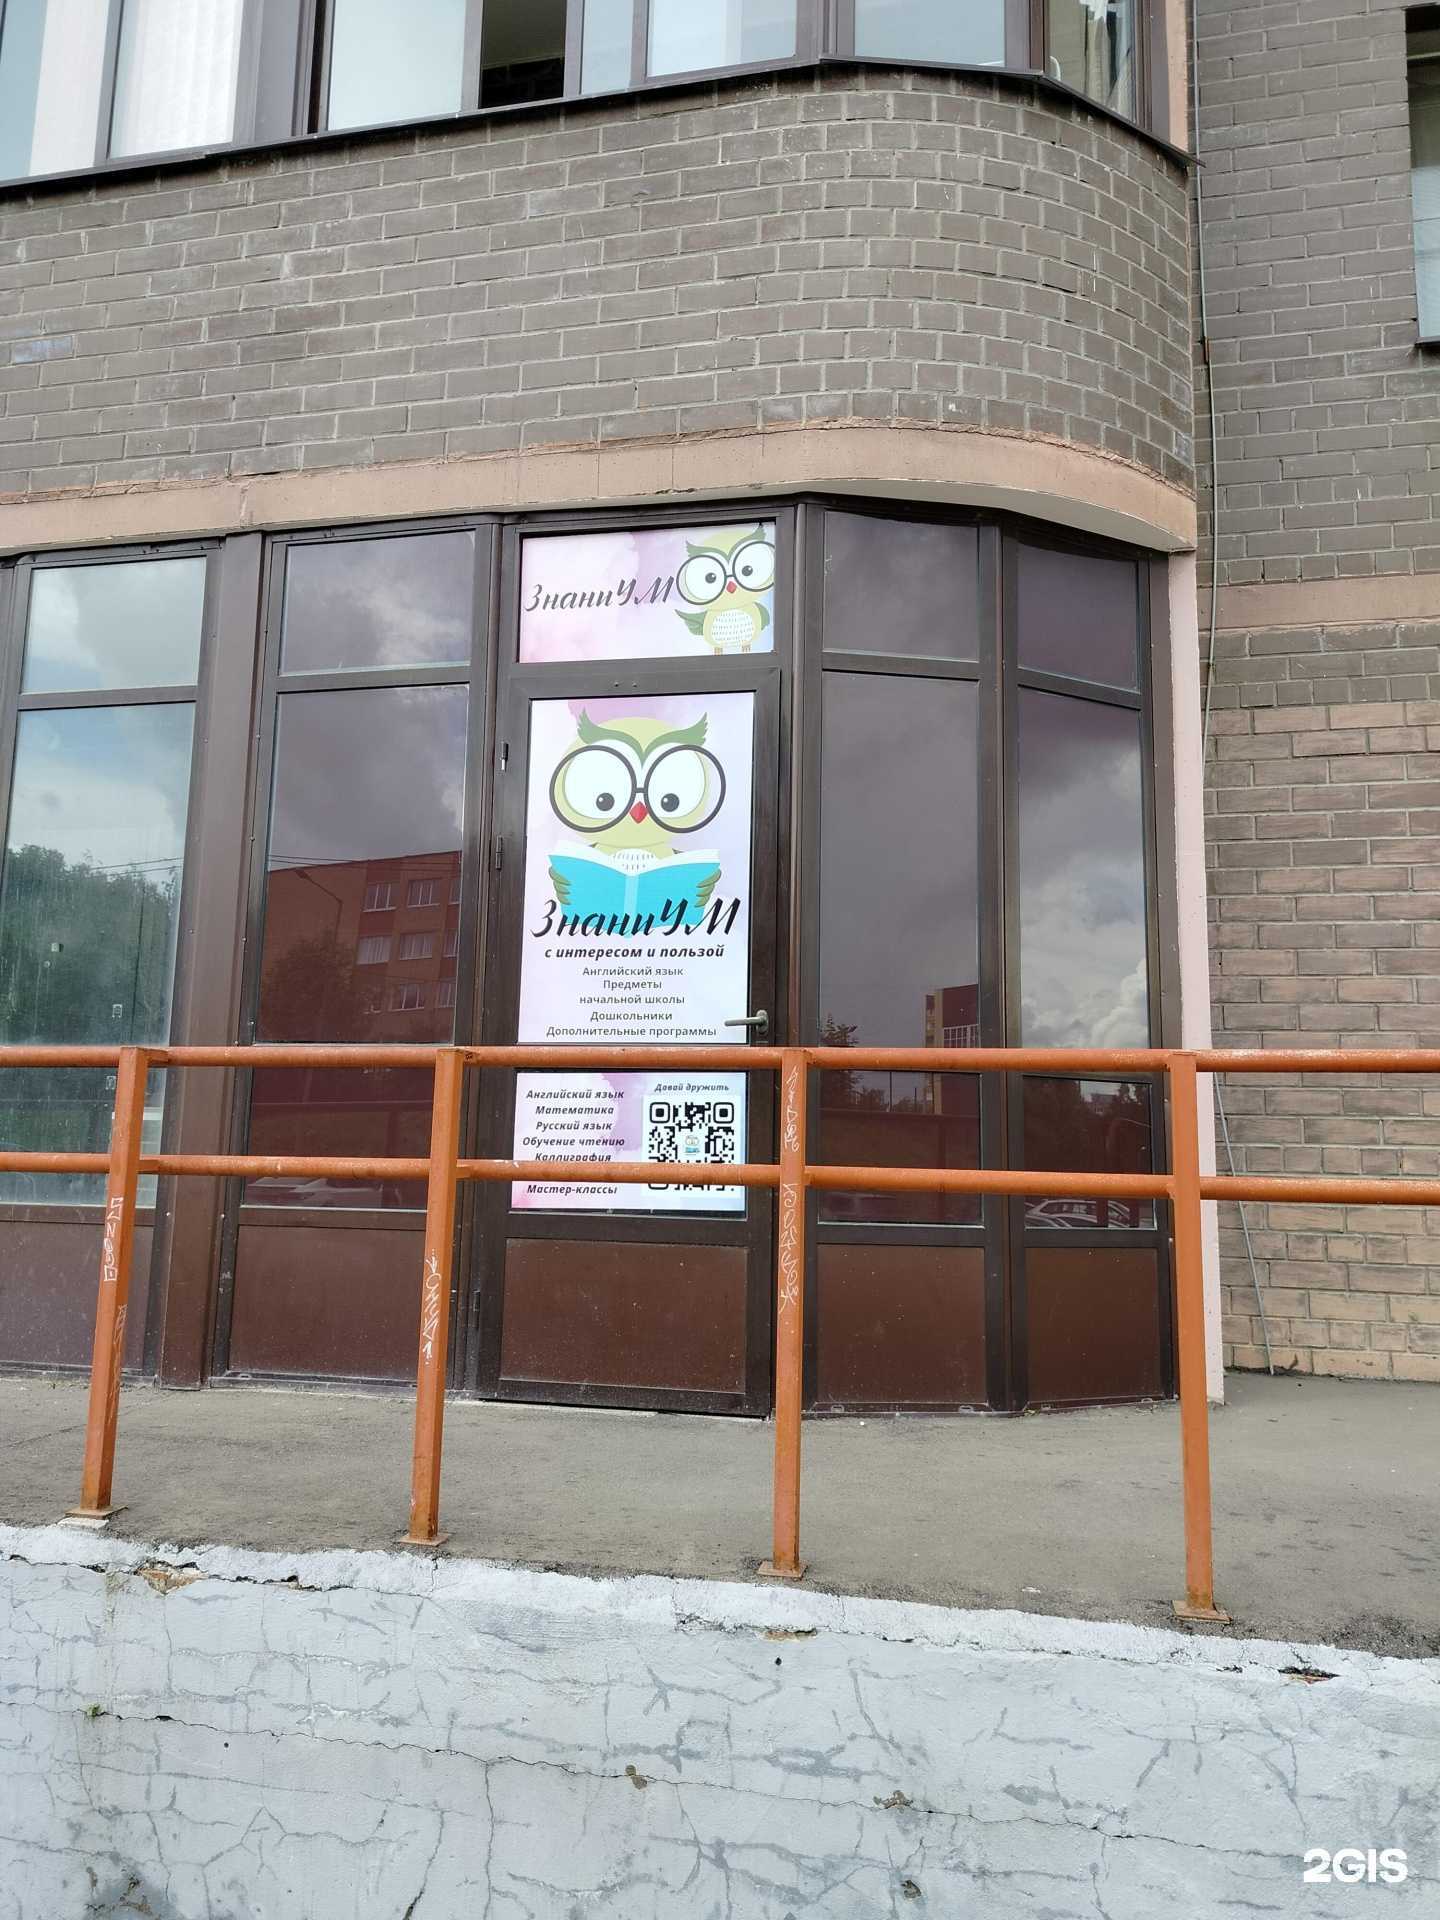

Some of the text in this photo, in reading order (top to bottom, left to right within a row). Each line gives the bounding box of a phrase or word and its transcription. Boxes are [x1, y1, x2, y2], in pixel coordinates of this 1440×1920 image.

[530, 897, 741, 938] ЗнаниУМ
[544, 945, 725, 961] с интересом и пользой
[582, 966, 684, 976] Английский язык
[603, 980, 662, 989] Предметы
[579, 994, 685, 1004] начальной школы
[590, 1011, 673, 1021] Дошкольники
[546, 1026, 717, 1038] Дополнительные программы
[526, 1088, 625, 1099] Английский язык
[654, 1083, 729, 1093] Давай дружить
[535, 1105, 614, 1115] Математика
[535, 1120, 612, 1132] Русский язык
[522, 1136, 625, 1148] Обучение чтению
[527, 1184, 618, 1196] Мастер-классы
